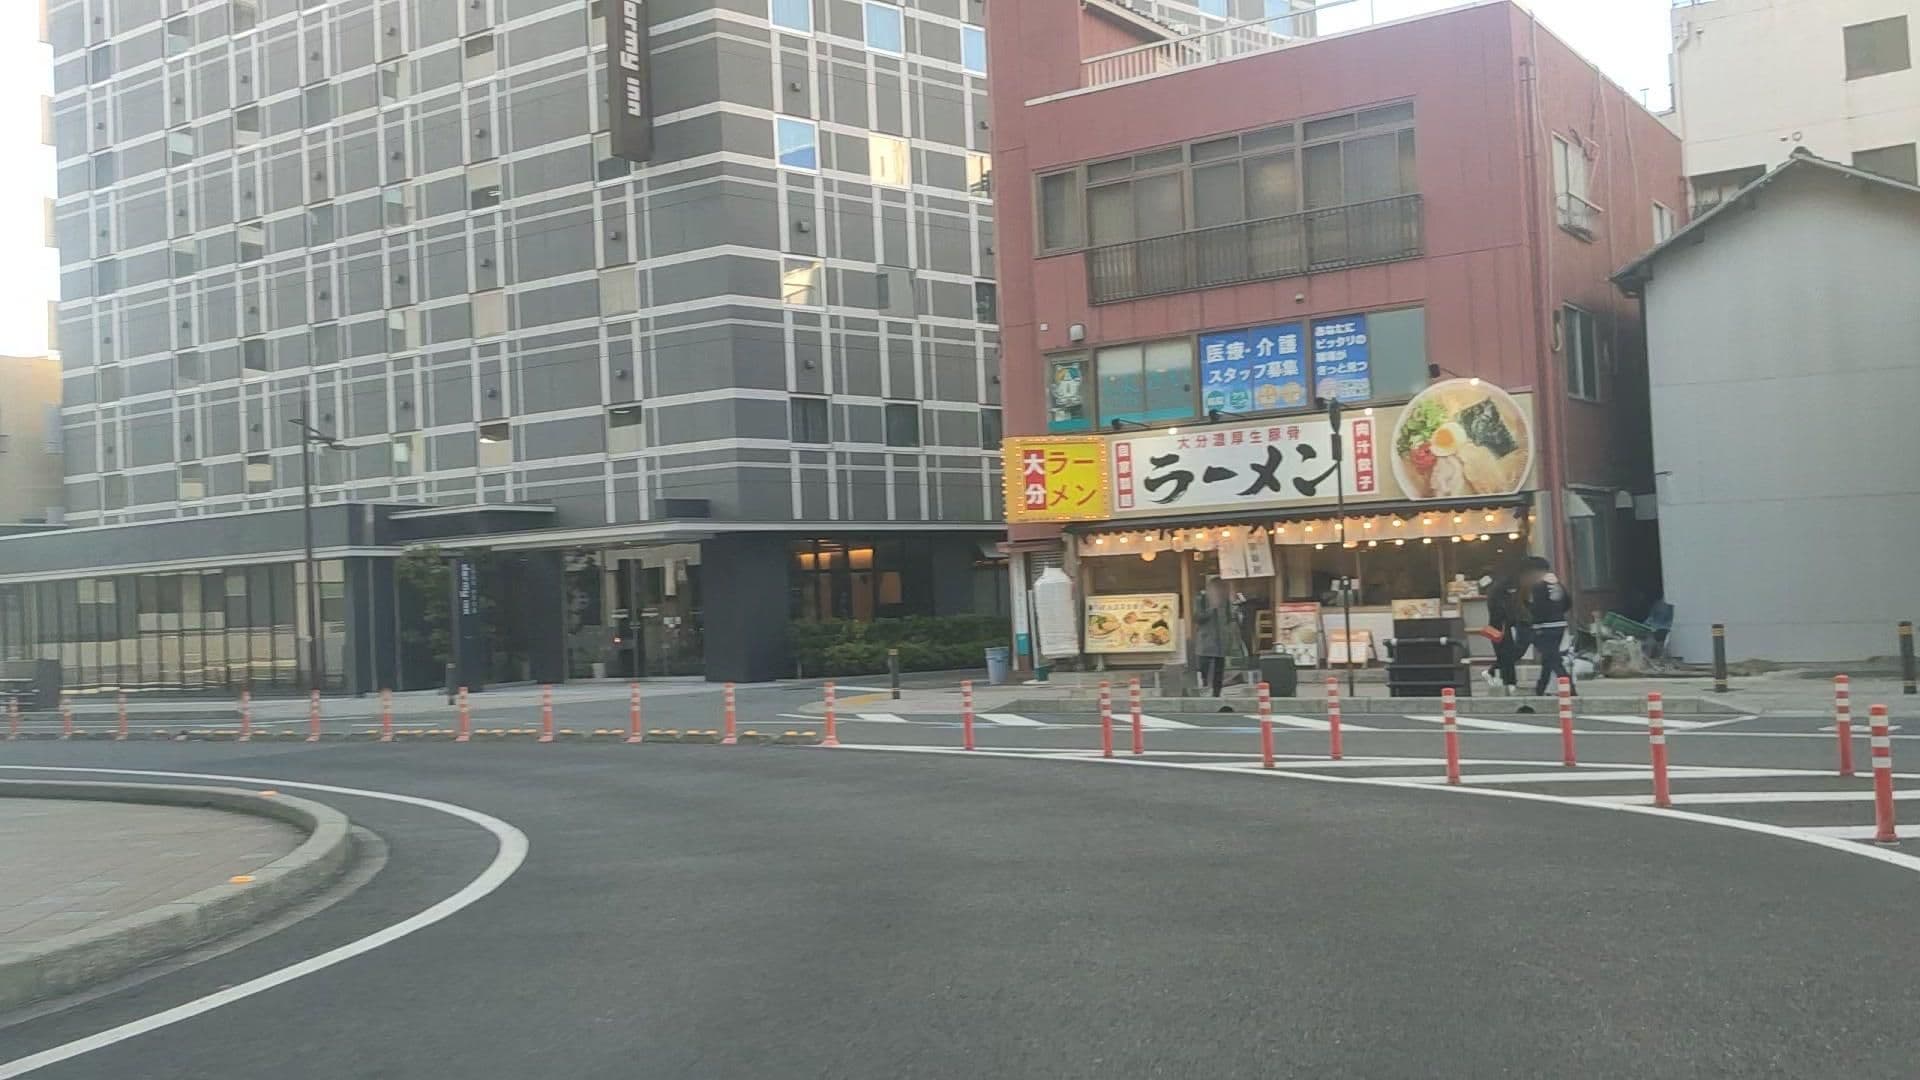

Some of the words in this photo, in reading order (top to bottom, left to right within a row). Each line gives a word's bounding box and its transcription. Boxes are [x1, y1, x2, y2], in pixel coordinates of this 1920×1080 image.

[620, 0, 643, 71] ormy
[626, 77, 641, 117] inn
[1209, 360, 1299, 384] スタッフ募集
[1024, 453, 1046, 505] 大分
[1144, 443, 1339, 505] ラーメン
